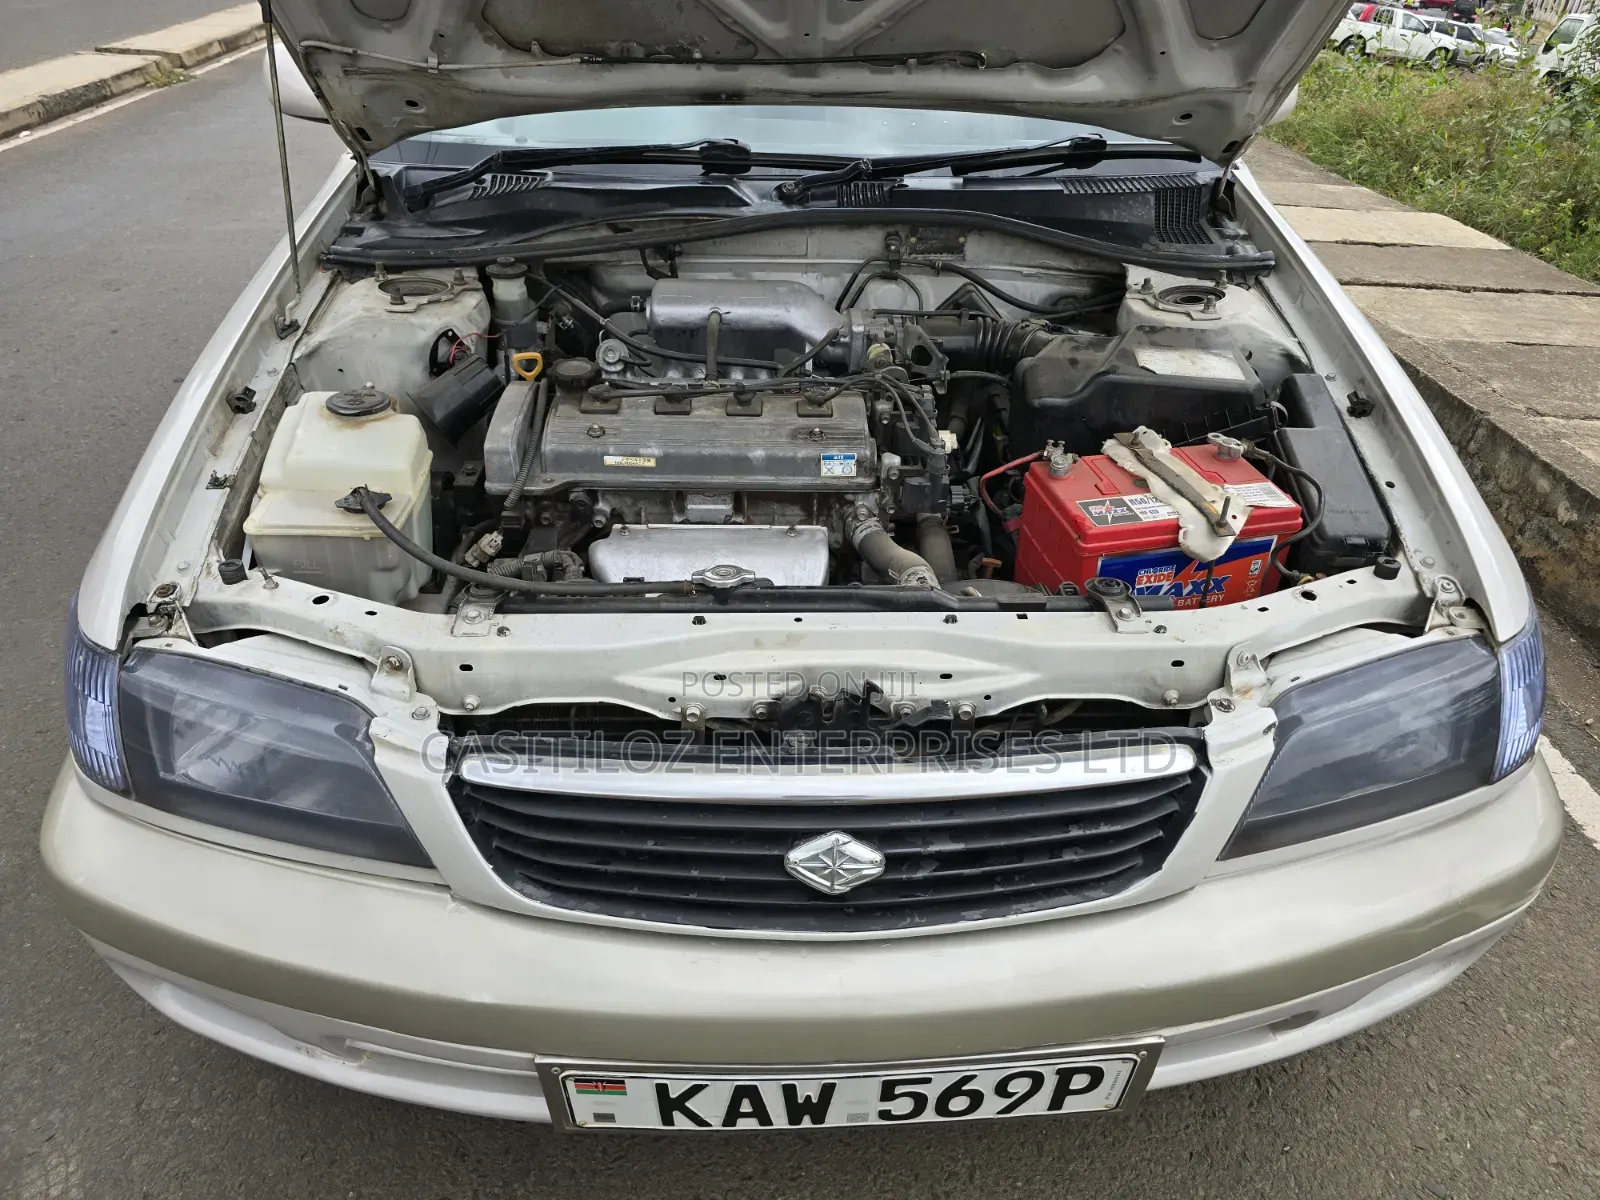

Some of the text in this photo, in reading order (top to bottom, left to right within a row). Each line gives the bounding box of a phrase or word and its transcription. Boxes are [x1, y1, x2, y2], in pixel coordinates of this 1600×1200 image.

[1138, 565, 1176, 576] CHLORIDE
[1133, 575, 1232, 597] MAXX
[1136, 573, 1174, 586] EXIDE
[1177, 594, 1224, 607] BATERY
[655, 1082, 837, 1128] KAW
[878, 1065, 1105, 1121] 569P
